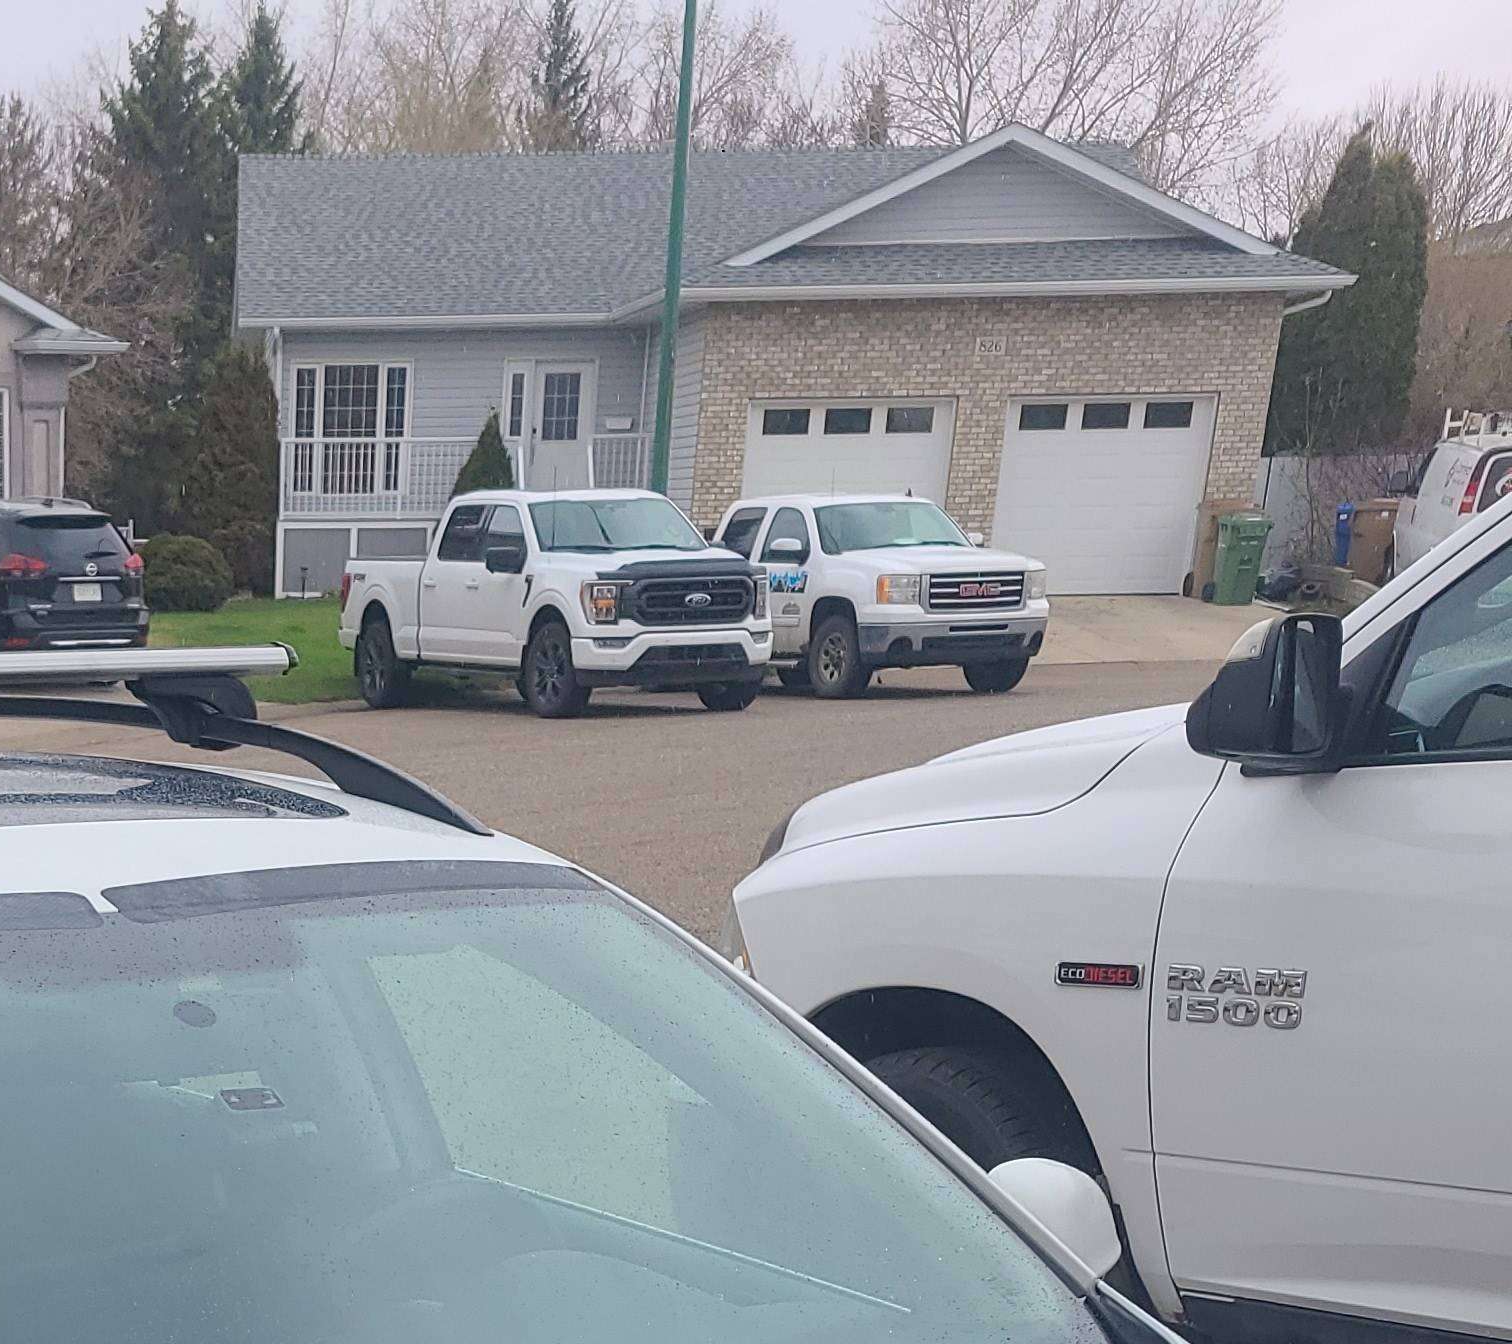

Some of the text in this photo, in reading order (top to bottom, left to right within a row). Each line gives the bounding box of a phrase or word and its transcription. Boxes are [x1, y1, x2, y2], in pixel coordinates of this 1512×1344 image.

[959, 582, 1001, 597] GMC
[1060, 967, 1134, 984] ECODIESEL
[1166, 962, 1308, 999] RAM
[1166, 994, 1303, 1030] 1500
